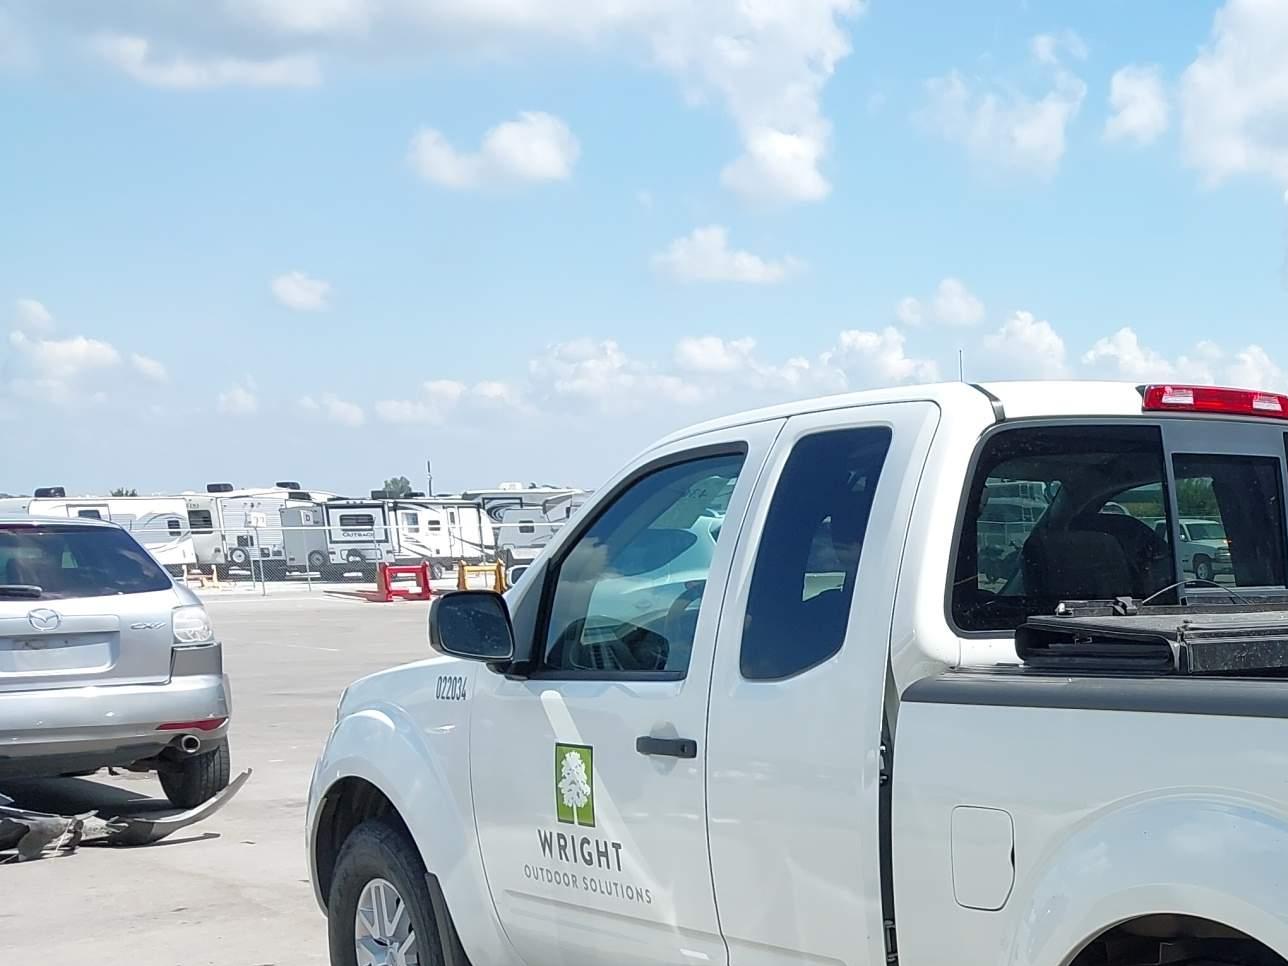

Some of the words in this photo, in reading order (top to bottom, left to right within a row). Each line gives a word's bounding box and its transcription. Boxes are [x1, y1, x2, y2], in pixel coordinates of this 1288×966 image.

[435, 676, 468, 701] 022034
[537, 828, 622, 872] WRIGHT
[523, 863, 578, 889] OUTDOOR
[582, 875, 652, 904] SOLUTIONS
